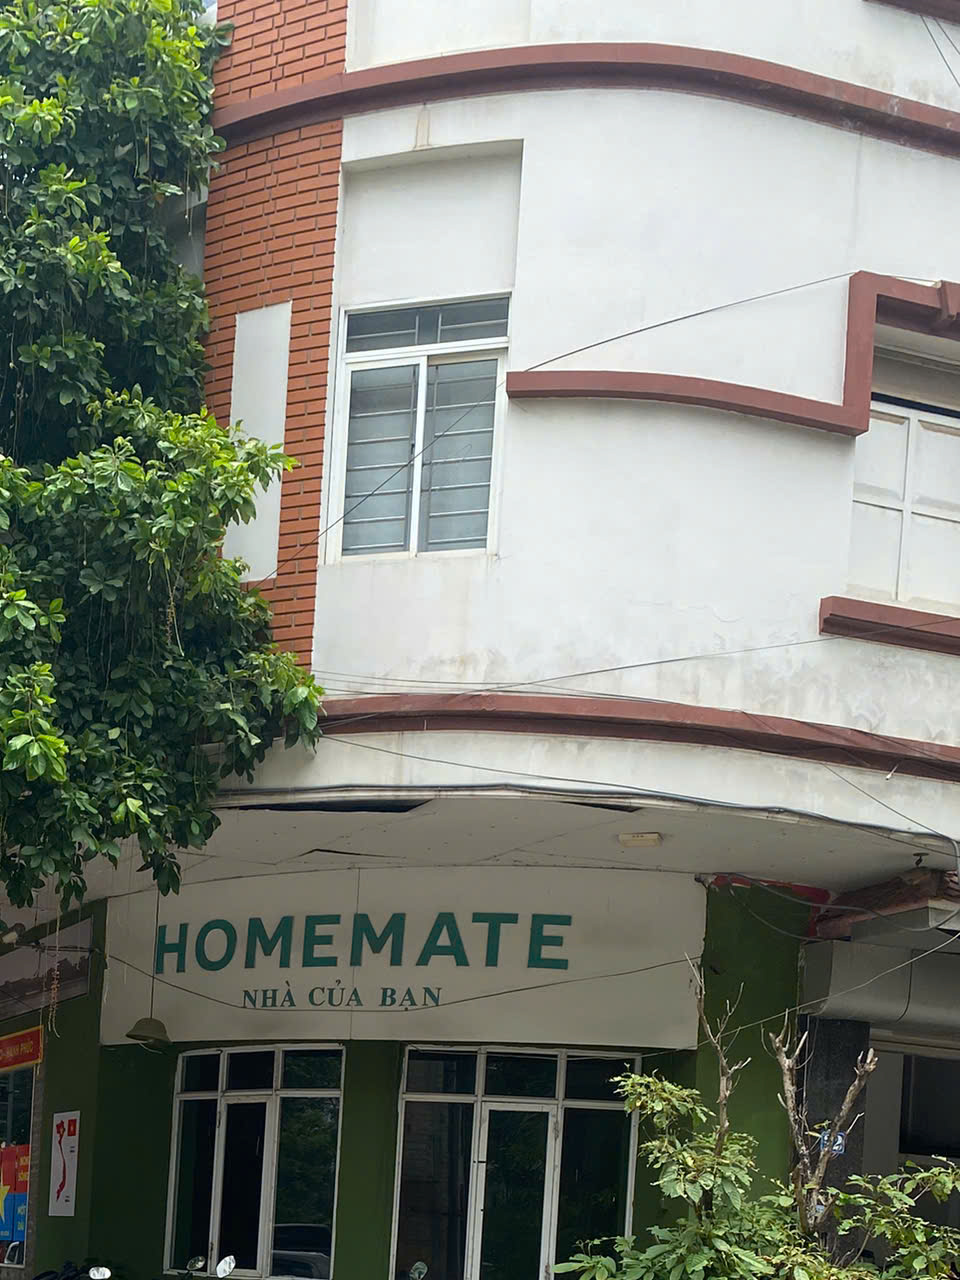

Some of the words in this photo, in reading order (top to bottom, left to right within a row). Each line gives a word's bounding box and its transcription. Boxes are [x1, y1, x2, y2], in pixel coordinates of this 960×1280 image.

[155, 912, 572, 974] HOMEMATE
[242, 981, 296, 1008] NHÀ
[308, 980, 364, 1008] CỦA
[380, 986, 442, 1012] BẠN
